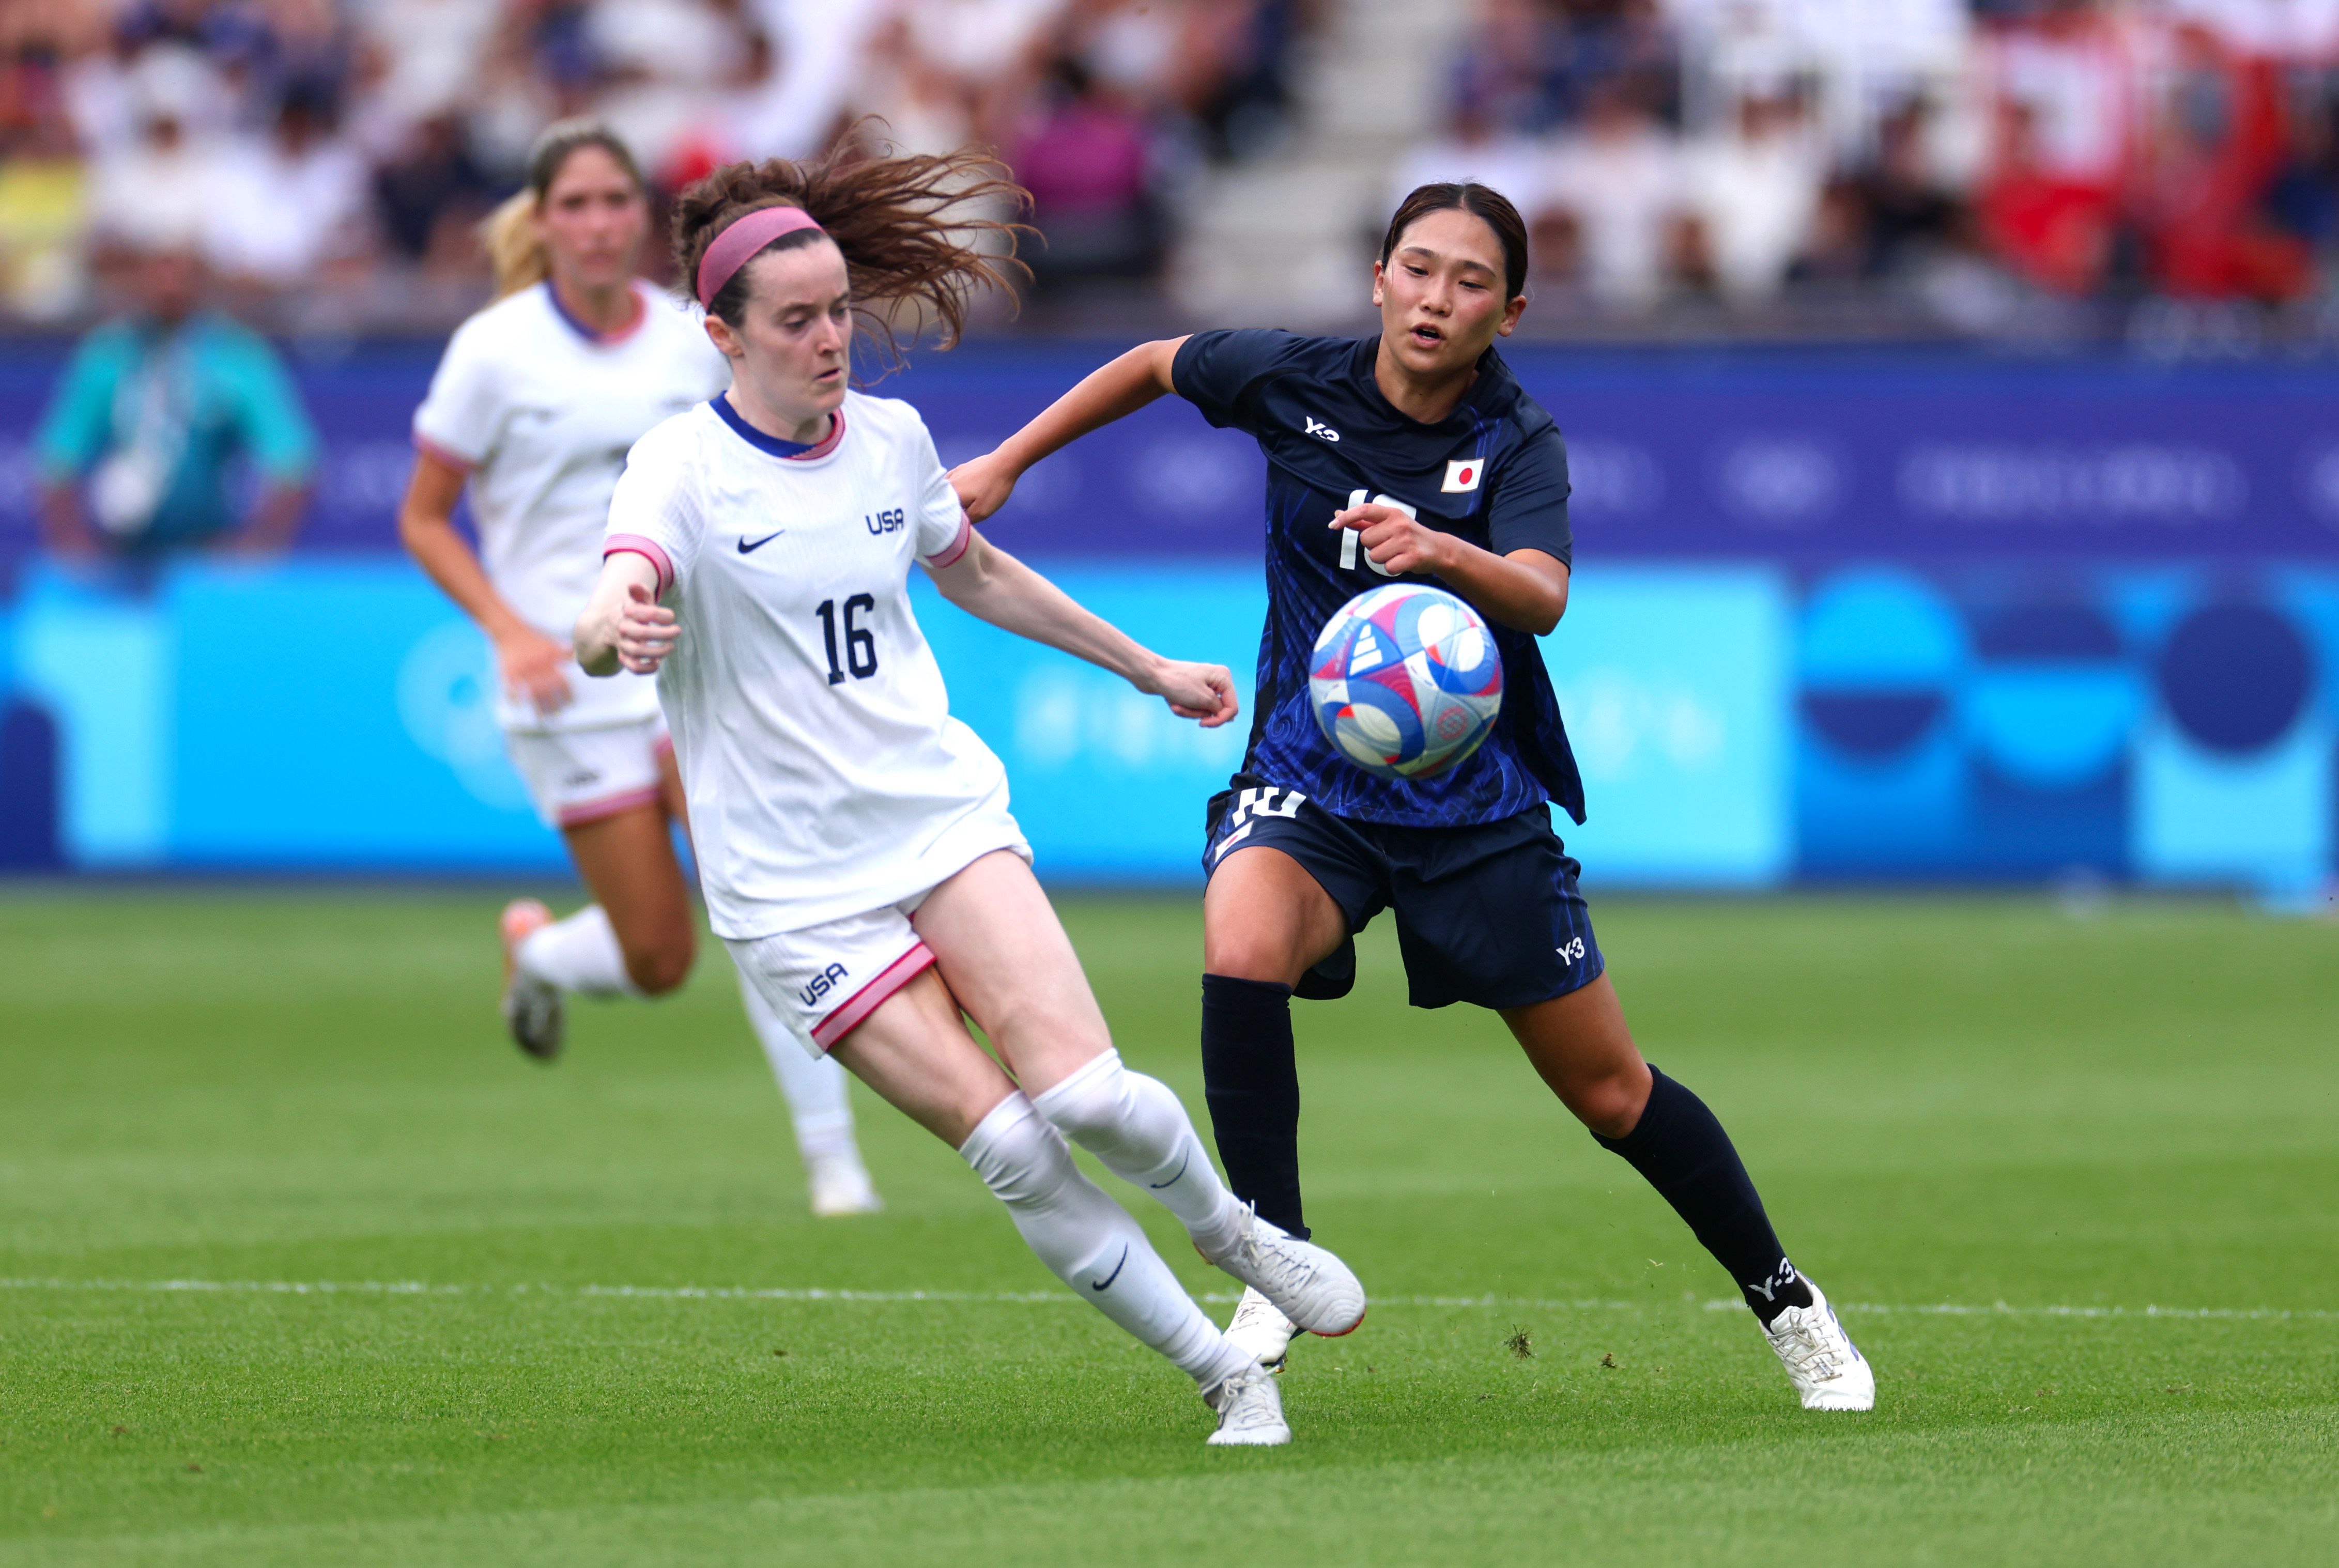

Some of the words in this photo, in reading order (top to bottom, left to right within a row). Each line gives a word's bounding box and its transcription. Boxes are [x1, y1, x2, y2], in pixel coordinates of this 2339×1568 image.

[865, 508, 903, 535] USA
[815, 593, 878, 686] 16
[1556, 937, 1585, 966] Y-3
[799, 962, 849, 1007] USA
[1748, 1257, 1796, 1302] Y-3
